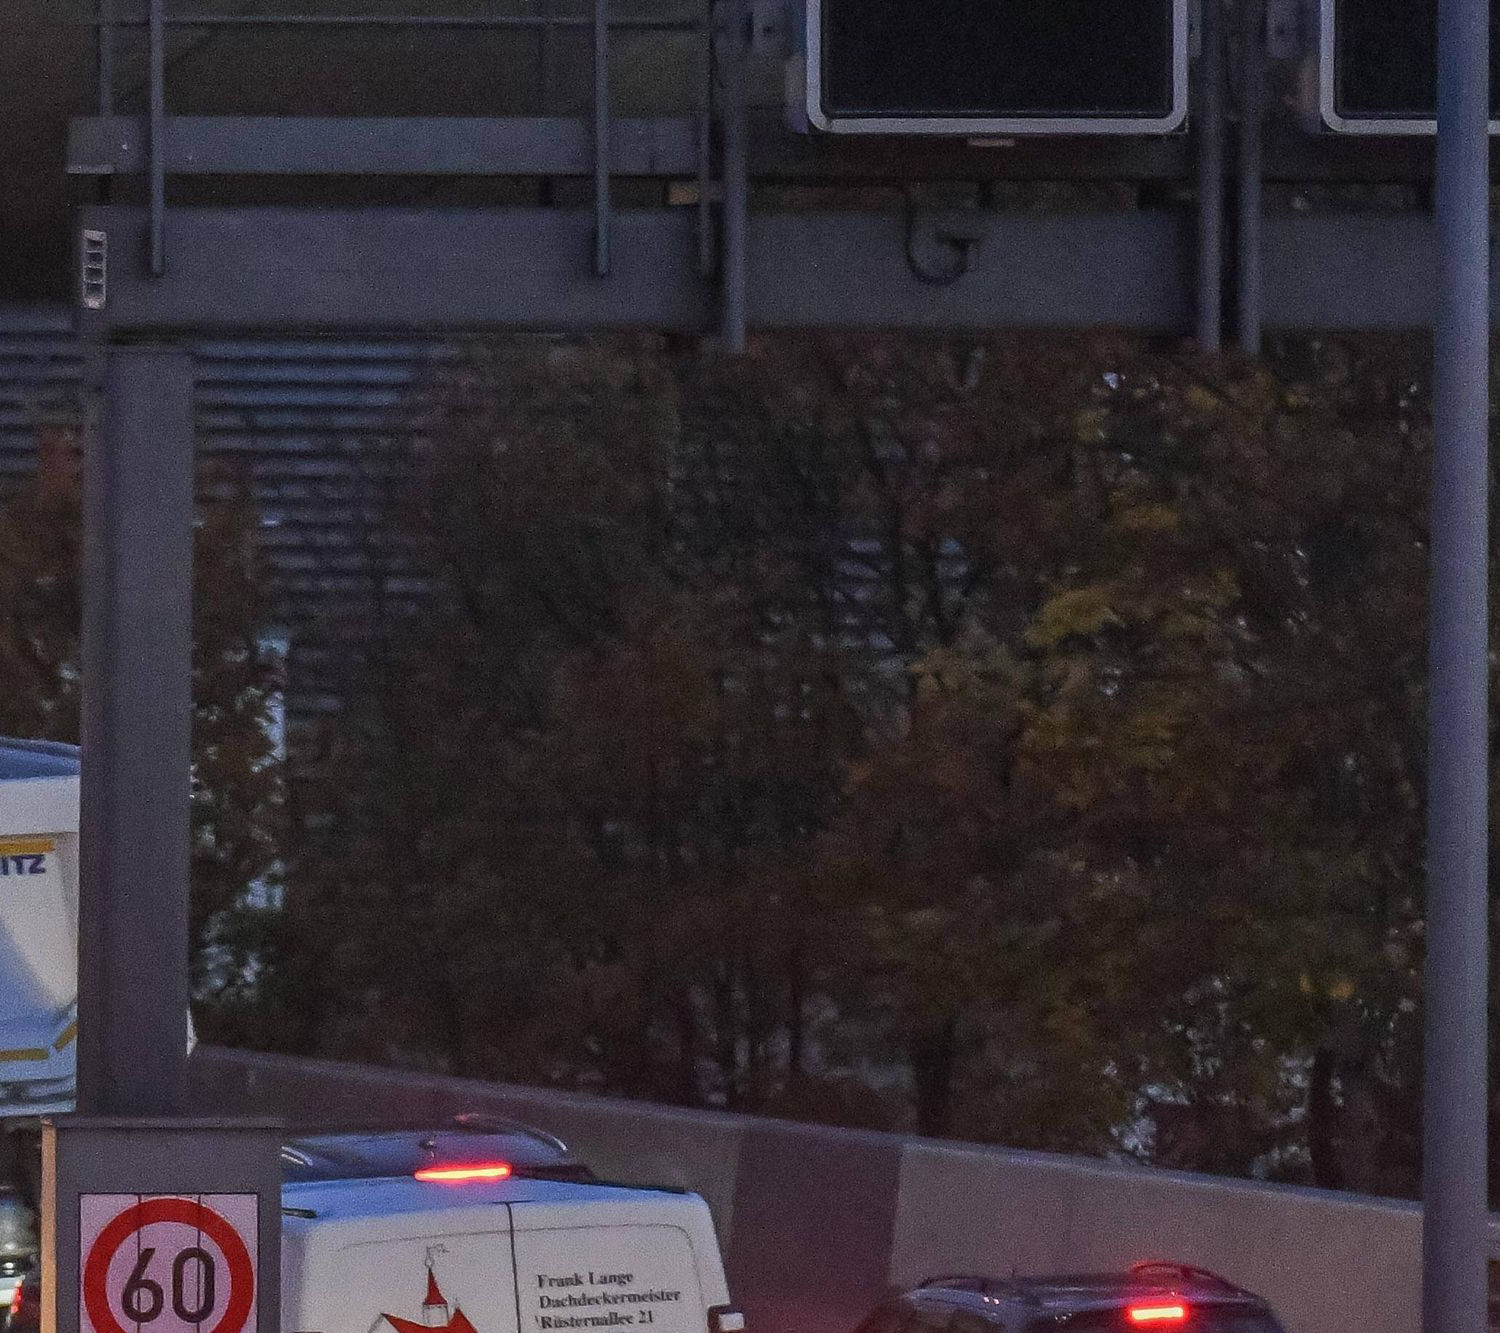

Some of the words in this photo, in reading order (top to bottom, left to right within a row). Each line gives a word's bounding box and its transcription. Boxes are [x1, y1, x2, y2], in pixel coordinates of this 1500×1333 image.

[121, 1246, 216, 1324] 60
[536, 1273, 583, 1288] Frank
[588, 1271, 633, 1287] Lange
[539, 1289, 680, 1309] Dachdeckermeister
[639, 1310, 653, 1323] 21
